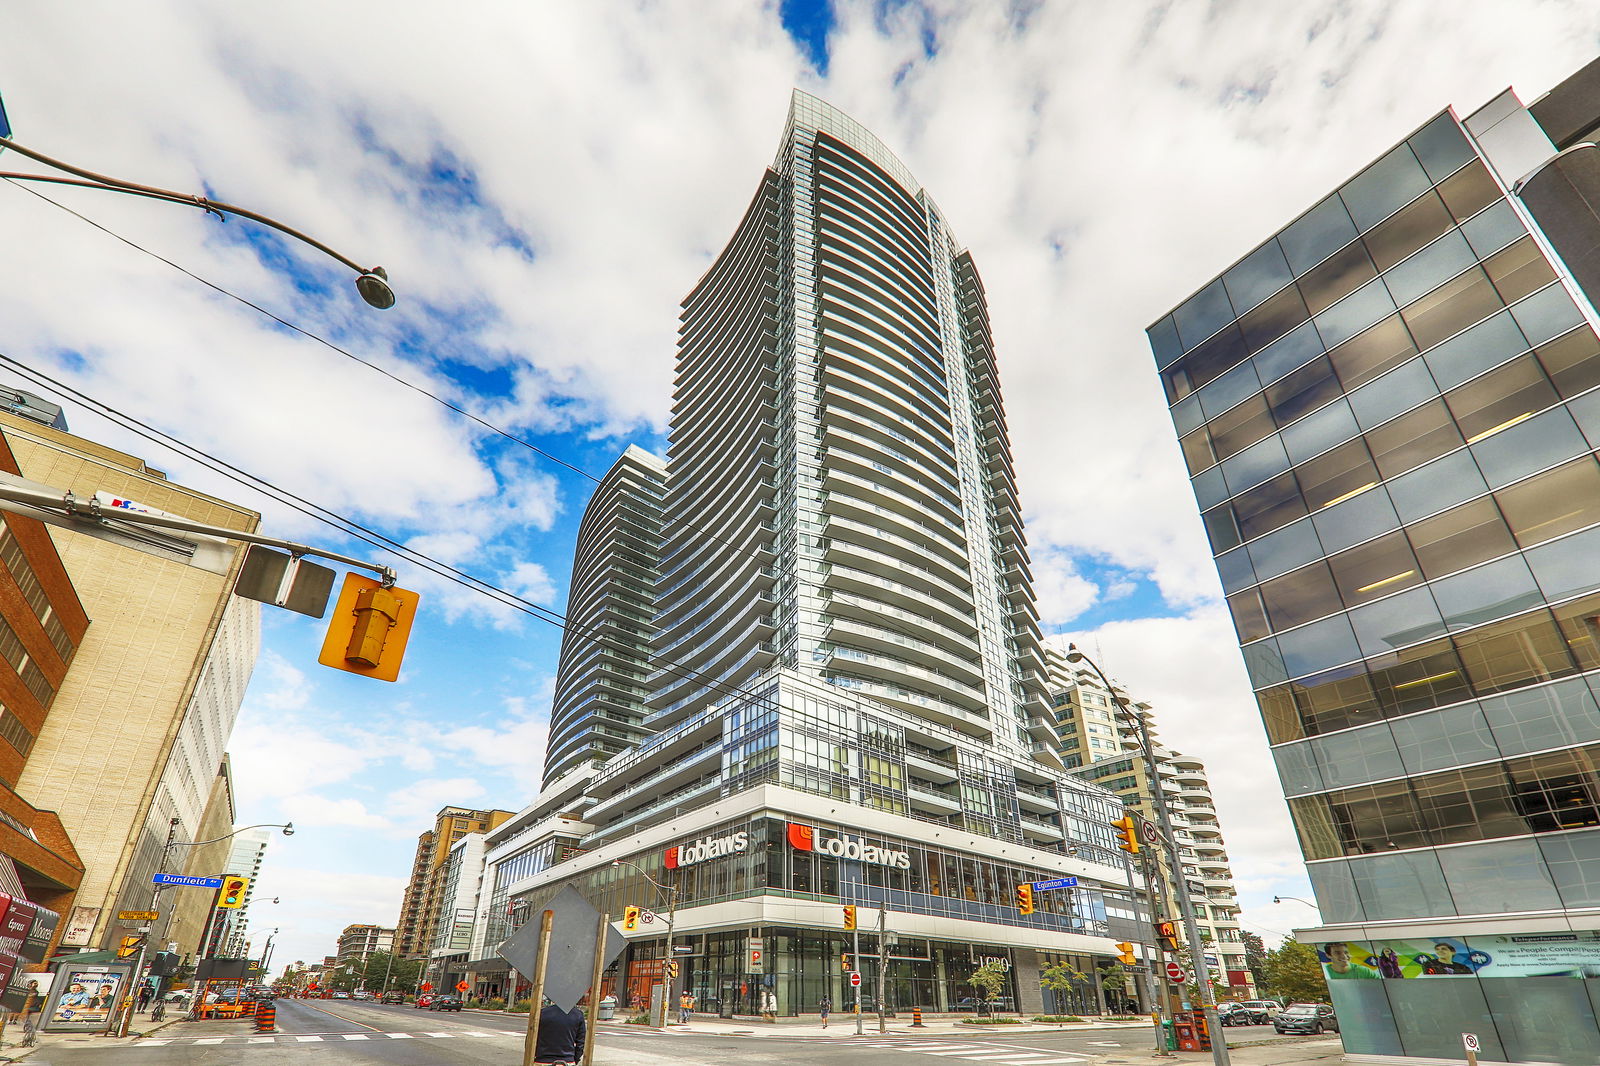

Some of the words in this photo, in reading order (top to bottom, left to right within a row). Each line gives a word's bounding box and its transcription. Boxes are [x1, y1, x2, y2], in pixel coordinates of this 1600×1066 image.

[677, 831, 748, 867] Loblaws
[813, 828, 911, 870] Loblaws
[162, 875, 207, 886] Dunfield
[1037, 880, 1063, 890] Eglinton
[1069, 877, 1075, 885] E
[8, 918, 25, 932] Express
[30, 917, 54, 941] Moores
